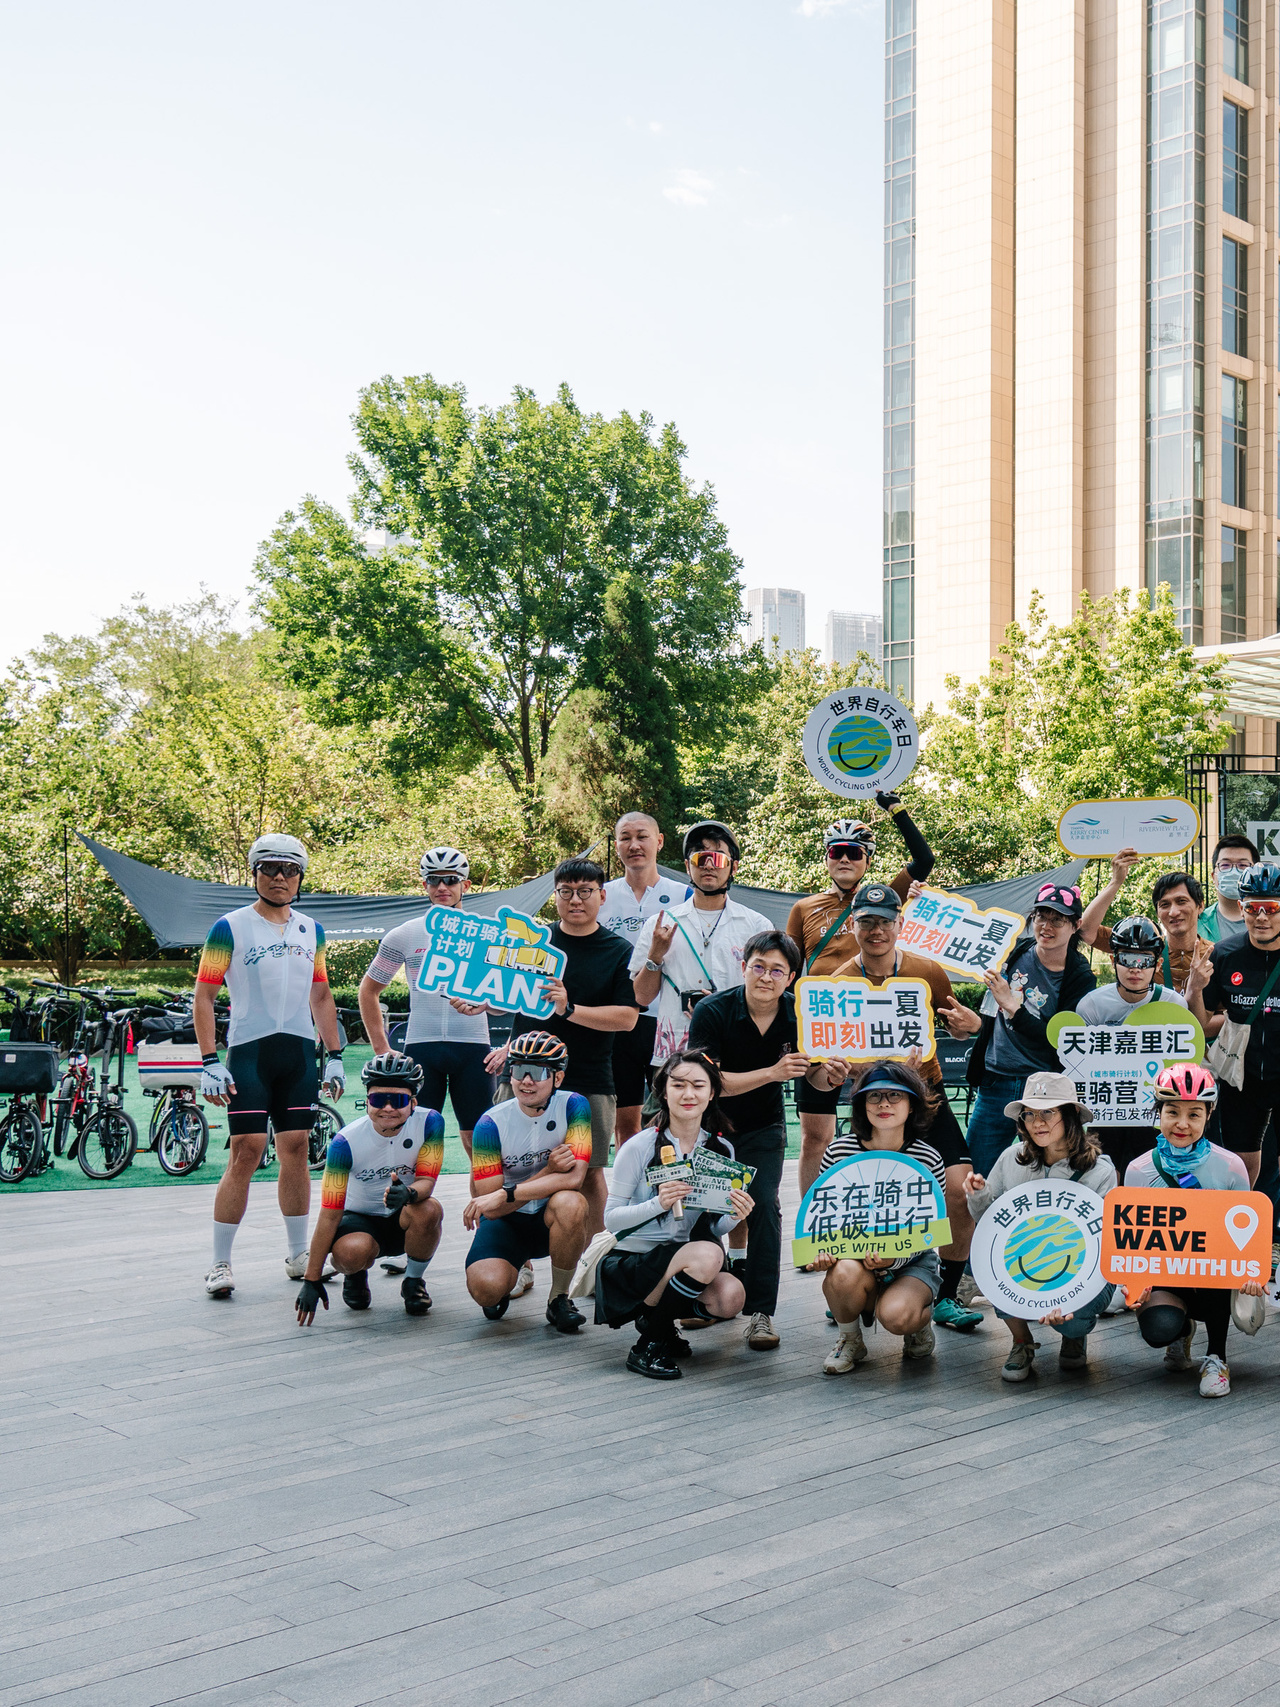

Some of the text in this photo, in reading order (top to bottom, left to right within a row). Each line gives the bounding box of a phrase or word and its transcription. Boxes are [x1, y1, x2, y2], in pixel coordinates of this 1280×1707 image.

[830, 696, 912, 747] 世界自行车日
[818, 756, 881, 790] WORLD CYCLING DAY
[912, 896, 1013, 946] 骑行一夏
[436, 934, 475, 959] 计划
[897, 920, 997, 970] 即刻出发
[808, 989, 921, 1018] 骑行一夏
[811, 1021, 924, 1050] 即刻出发
[1063, 1030, 1190, 1055] 天津嘉里汇
[810, 1176, 933, 1214] 乐在骑中
[808, 1206, 933, 1244] 低碳出行
[993, 1190, 1103, 1235] 世界自行车日
[1114, 1204, 1187, 1227] KEEP
[852, 1242, 886, 1253] WITH
[894, 1239, 912, 1251] US
[1114, 1228, 1207, 1252] WAVE
[1110, 1255, 1260, 1277] RIDE WITH US
[997, 1281, 1085, 1308] WORLD CYCLING DAY
